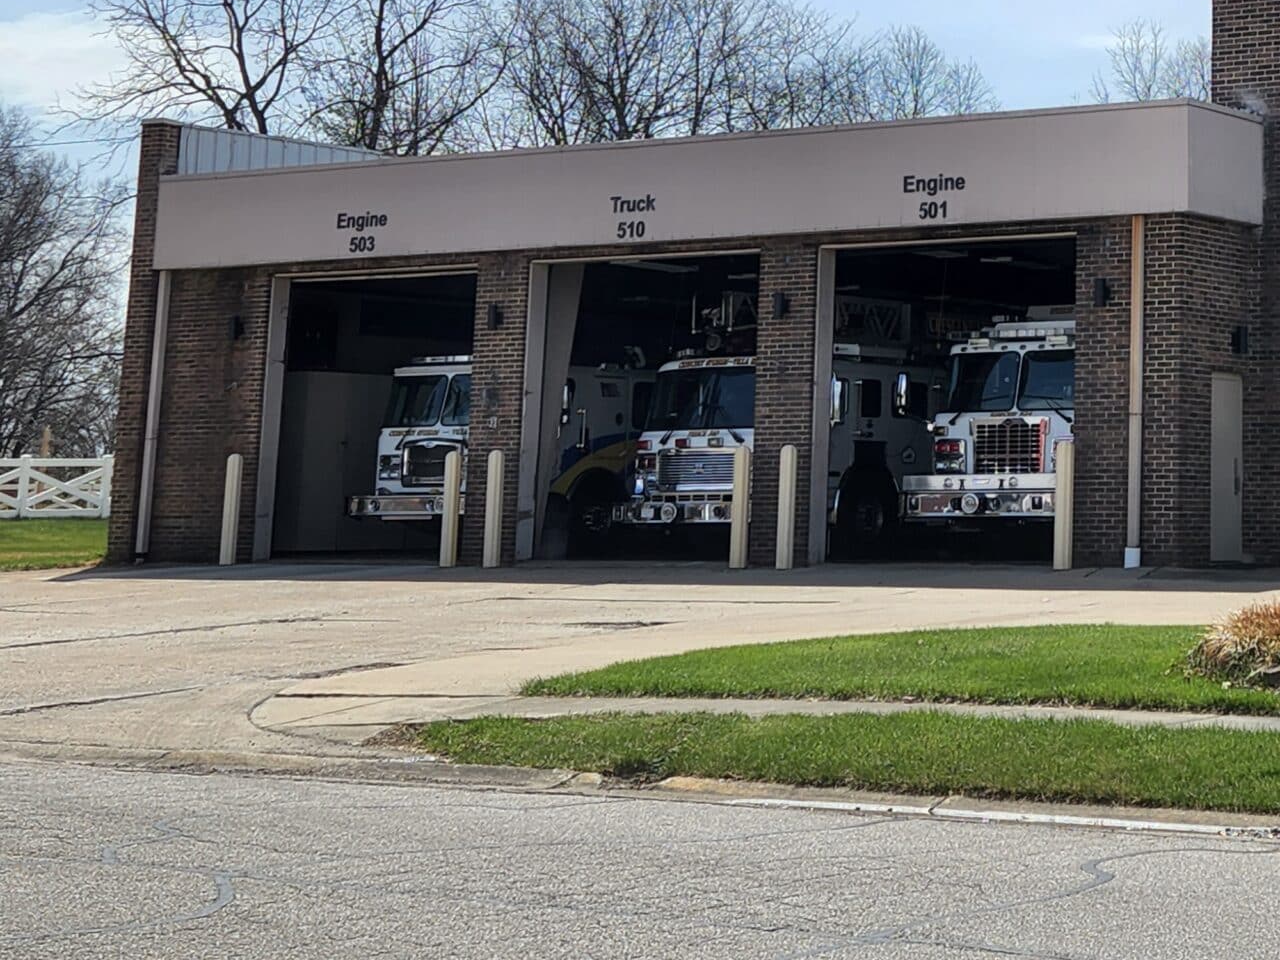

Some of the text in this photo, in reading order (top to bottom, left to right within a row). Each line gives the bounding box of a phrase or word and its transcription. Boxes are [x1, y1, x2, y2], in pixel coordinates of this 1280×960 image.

[903, 173, 966, 196] Engine
[610, 194, 656, 213] Truck
[919, 200, 947, 220] 501
[336, 210, 388, 232] Engine
[616, 220, 646, 239] 510
[348, 235, 376, 253] 503
